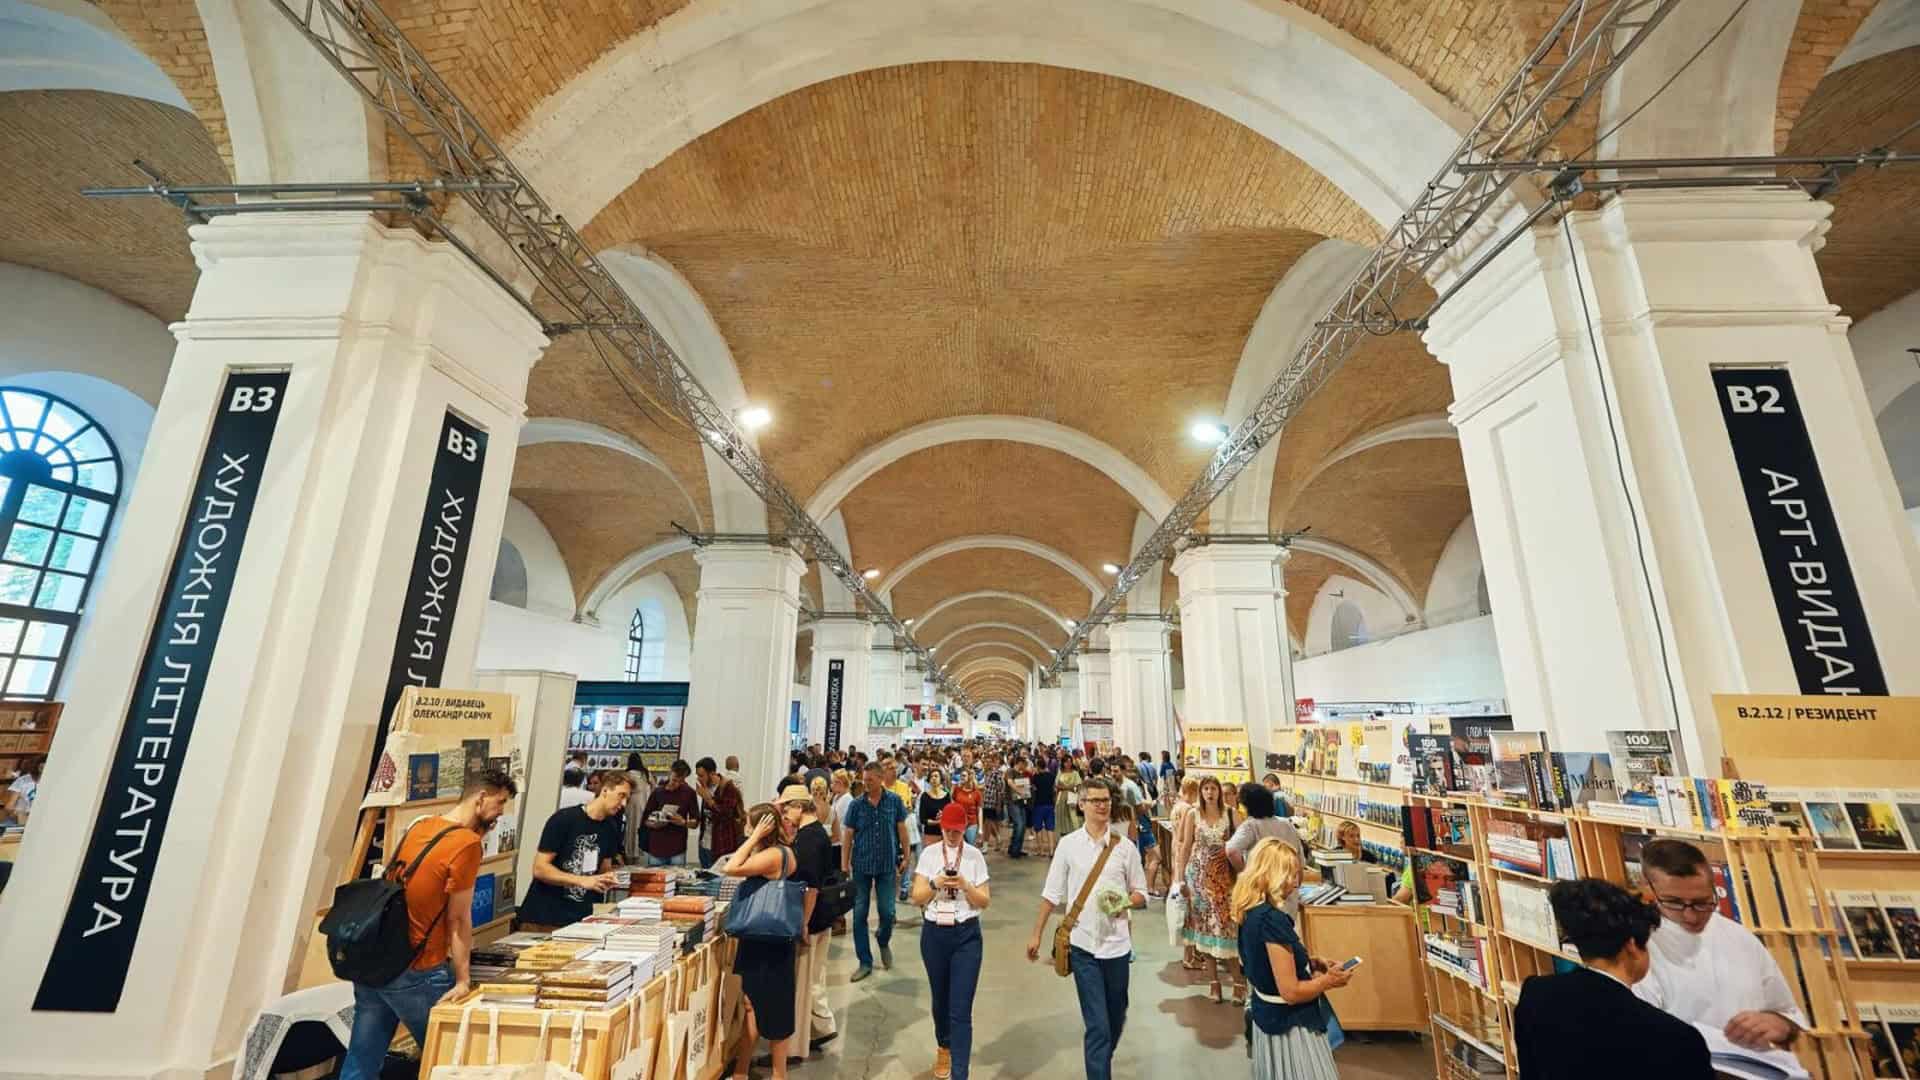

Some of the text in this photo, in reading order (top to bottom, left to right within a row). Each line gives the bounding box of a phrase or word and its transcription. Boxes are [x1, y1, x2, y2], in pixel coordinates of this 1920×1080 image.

[409, 489, 465, 662] ХУДОЖНЯ
[82, 453, 250, 938] ХУДОЖНЯ ЛІТЕРАТУРА
[445, 698, 485, 708] ВИДАВЕЦЬ
[413, 708, 493, 720] ОЛЕКСАНДР САВЧУК
[1795, 708, 1878, 722] РЕЗИДЕНТ
[1626, 735, 1650, 745] 100
[1569, 774, 1615, 790] Meier
